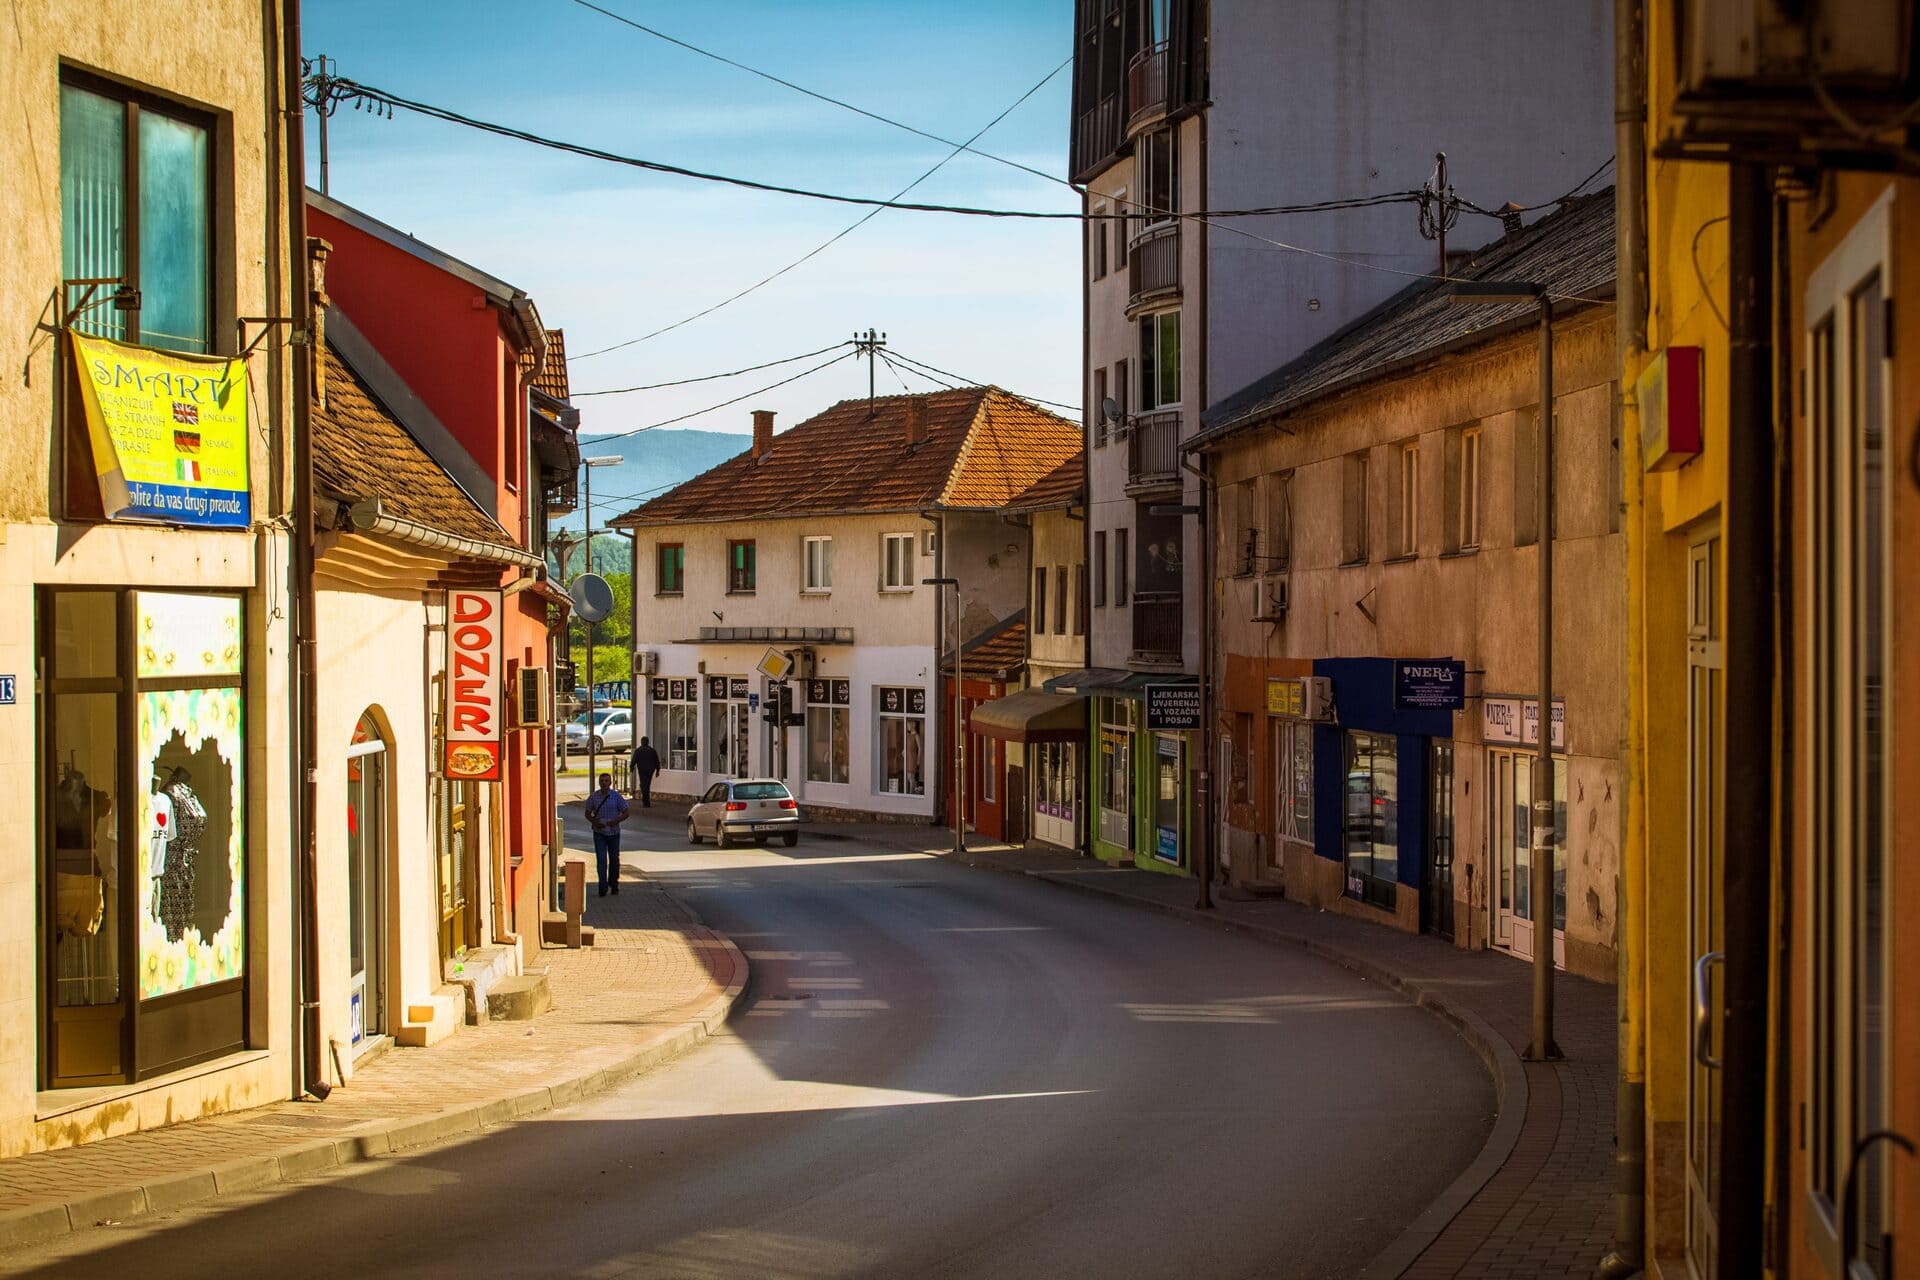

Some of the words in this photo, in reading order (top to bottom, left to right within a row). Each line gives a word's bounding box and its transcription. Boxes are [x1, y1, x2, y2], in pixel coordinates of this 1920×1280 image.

[94, 360, 223, 405] SMART
[129, 483, 151, 507] olite
[153, 485, 165, 508] da
[167, 495, 182, 510] vas
[184, 487, 207, 517] drugi
[210, 492, 242, 517] prevode
[453, 594, 493, 735] DONER
[1411, 667, 1452, 680] NERA
[0, 679, 14, 700] 13
[1153, 691, 1200, 699] LJEKARSKA
[1153, 699, 1199, 707] UVJERENJA
[1151, 708, 1161, 716] ZA
